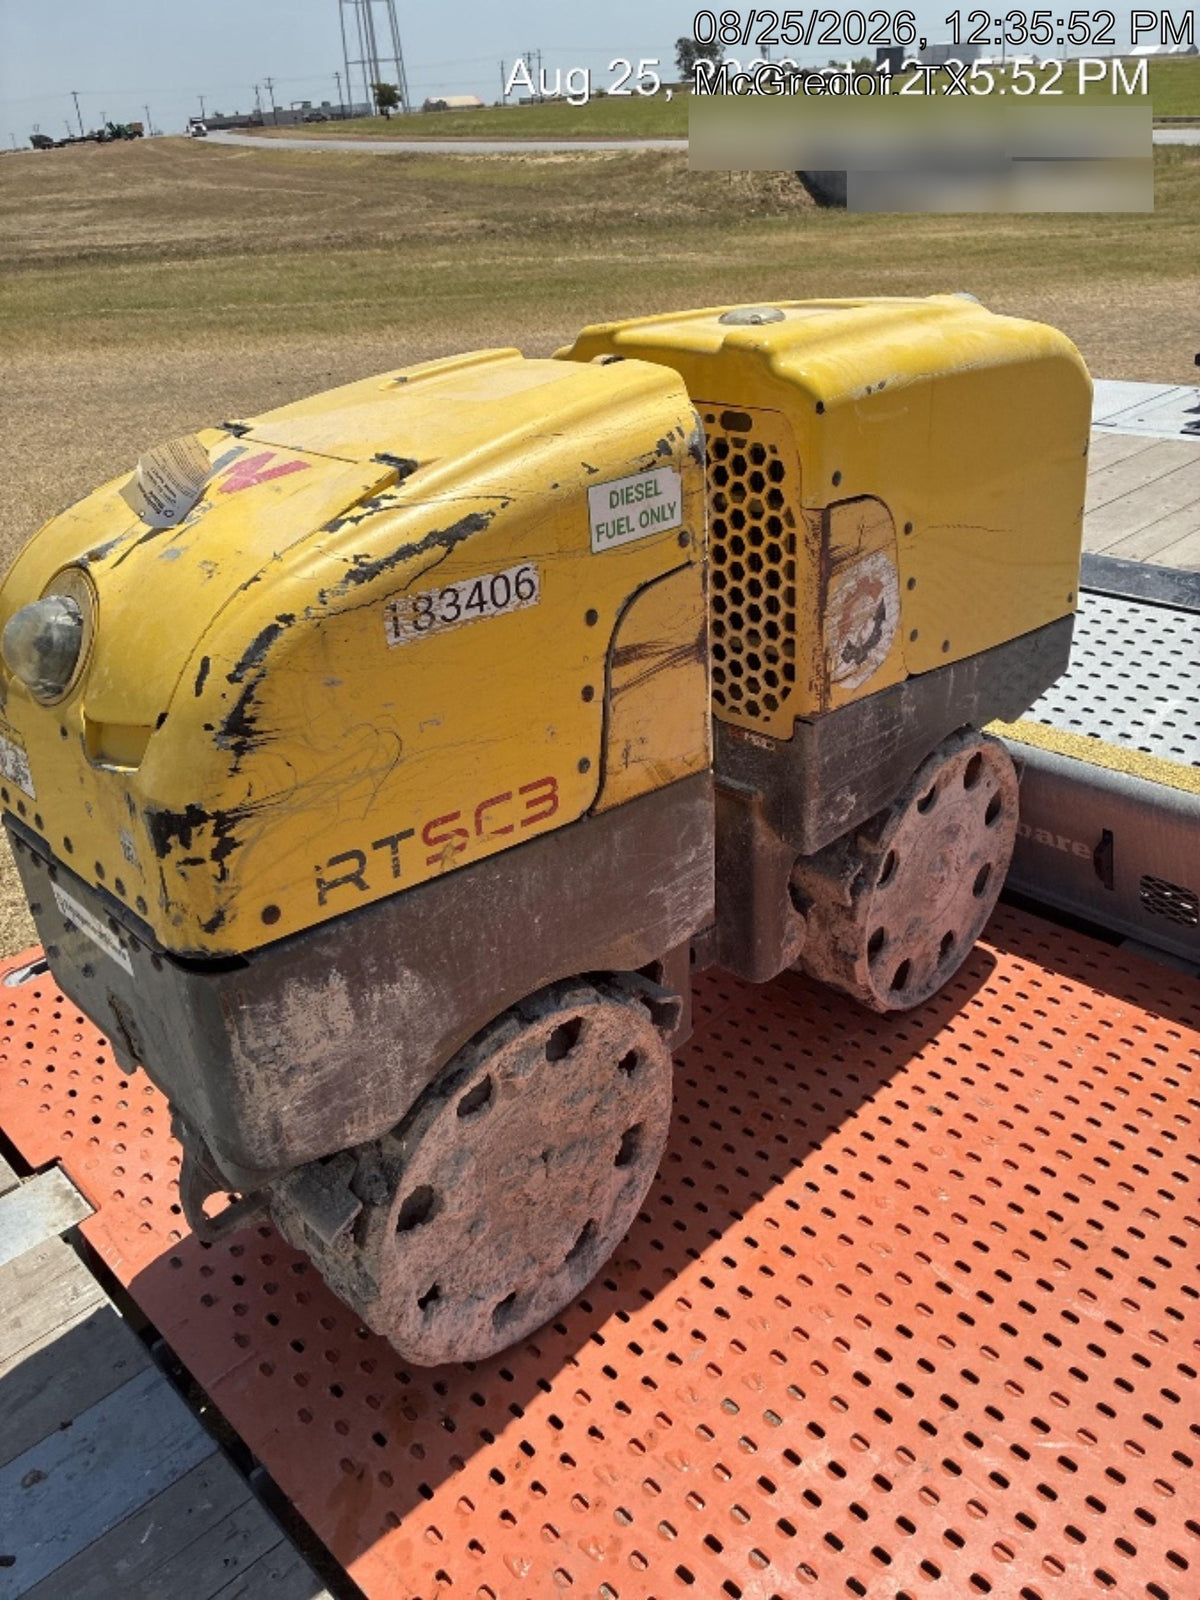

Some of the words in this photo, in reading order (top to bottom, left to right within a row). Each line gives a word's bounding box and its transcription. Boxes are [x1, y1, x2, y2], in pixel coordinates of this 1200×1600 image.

[608, 479, 663, 510] DIESEL
[596, 515, 636, 543] FUEL
[639, 501, 677, 528] ONLY
[385, 566, 536, 639] 183406
